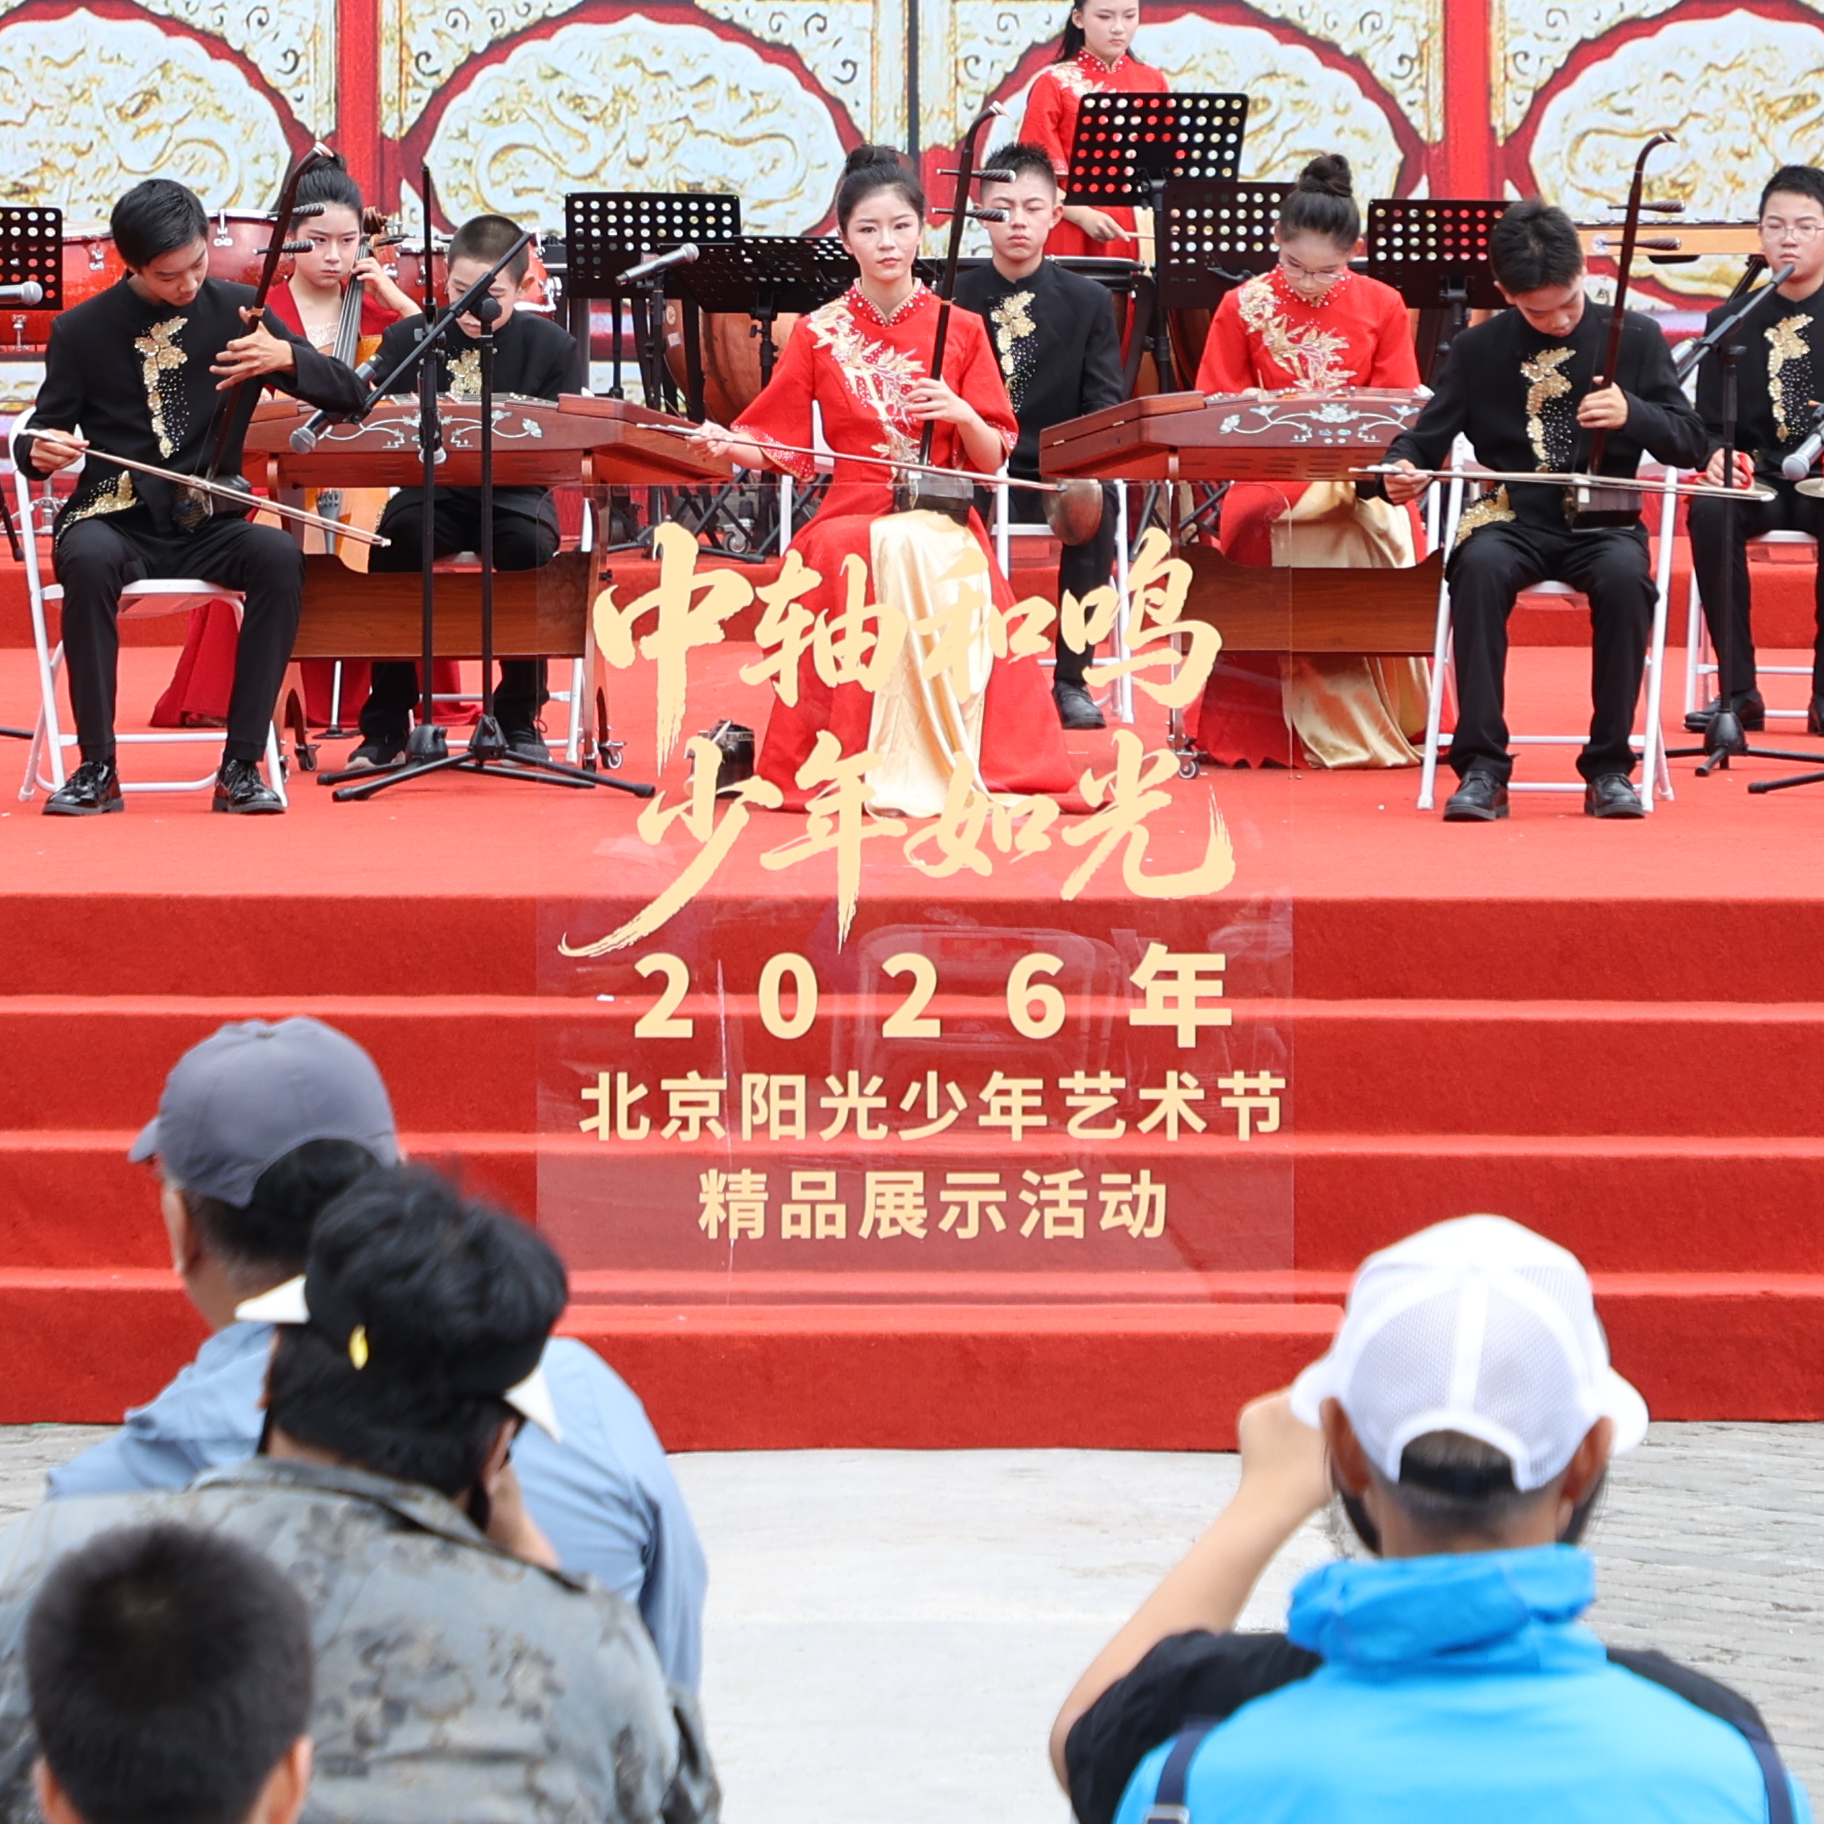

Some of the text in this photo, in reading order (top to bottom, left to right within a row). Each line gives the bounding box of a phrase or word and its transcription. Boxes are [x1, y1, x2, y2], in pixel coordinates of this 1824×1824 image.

[593, 521, 1223, 777] 中轴和鸣
[557, 729, 1235, 958] 少年如光
[633, 942, 1233, 1048] 2026年
[579, 1070, 1287, 1143] 北京阳光少年艺术节
[698, 1169, 1167, 1240] 精品展示活动
